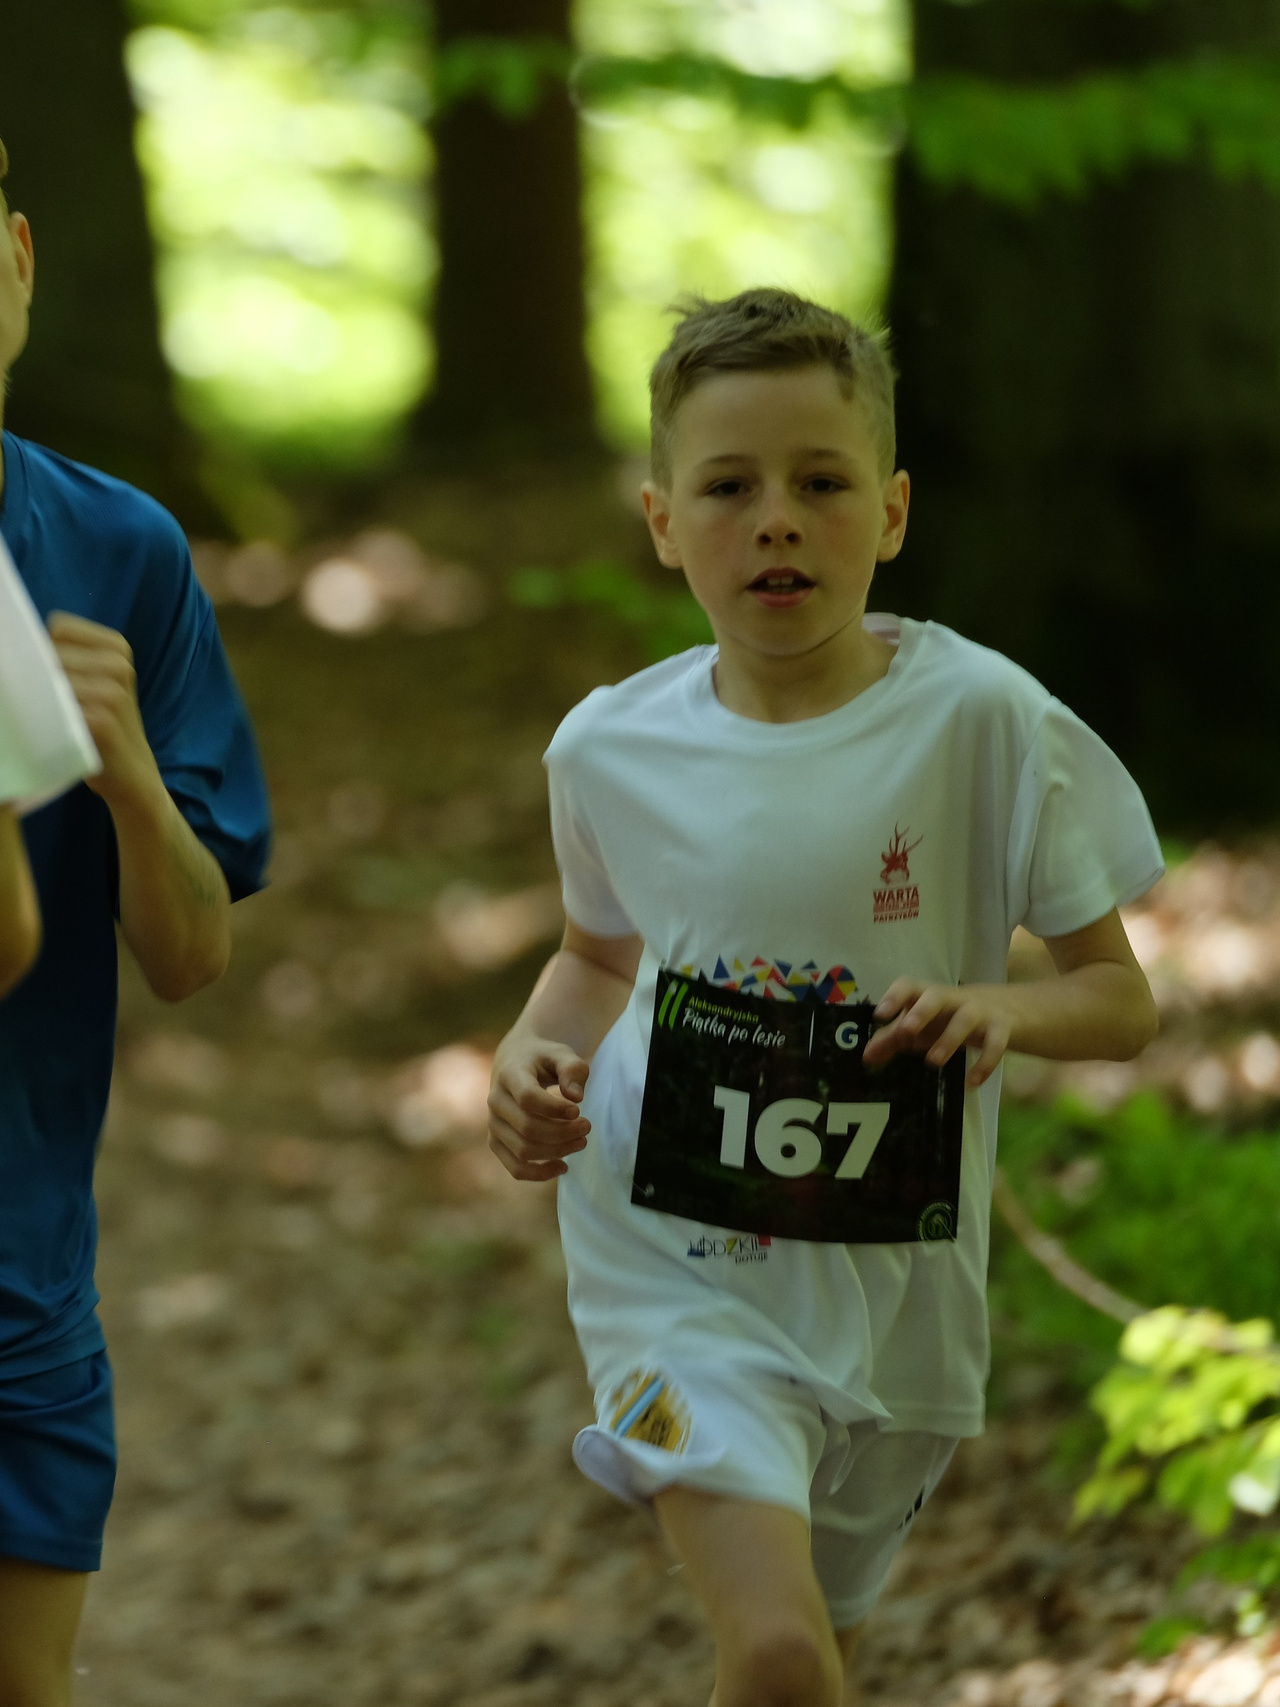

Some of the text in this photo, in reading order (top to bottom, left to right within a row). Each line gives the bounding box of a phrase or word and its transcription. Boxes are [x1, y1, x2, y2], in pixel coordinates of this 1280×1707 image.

[873, 887, 919, 903] WARTA
[688, 995, 760, 1024] Aleksandryjska
[682, 1006, 787, 1050] Piątka po lesie
[834, 1020, 860, 1051] G
[713, 1084, 892, 1181] 167
